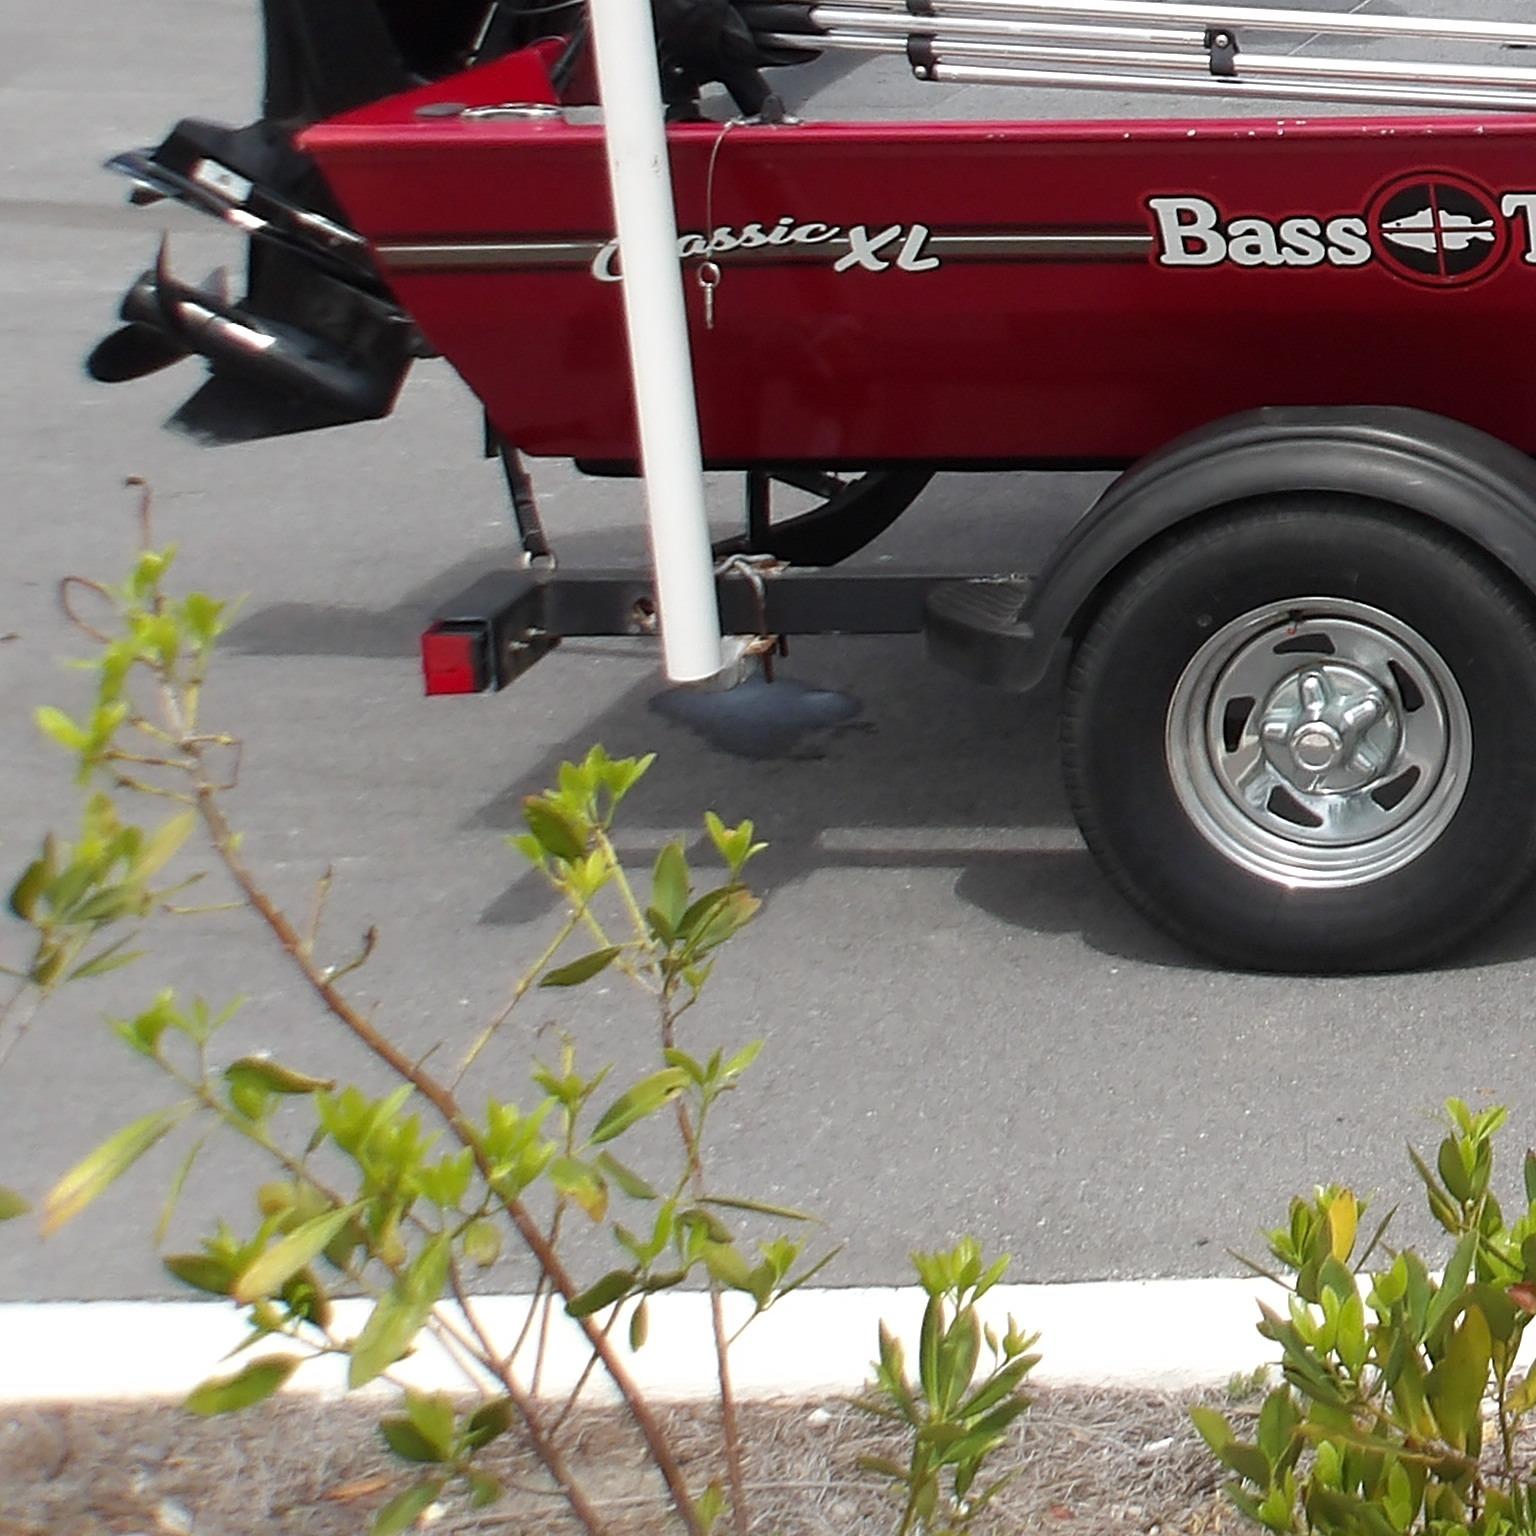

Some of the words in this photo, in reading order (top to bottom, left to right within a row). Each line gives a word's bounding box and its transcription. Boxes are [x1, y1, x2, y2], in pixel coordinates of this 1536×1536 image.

[591, 217, 840, 282] Cassic
[833, 223, 941, 273] XL
[1149, 197, 1372, 265] Bass
